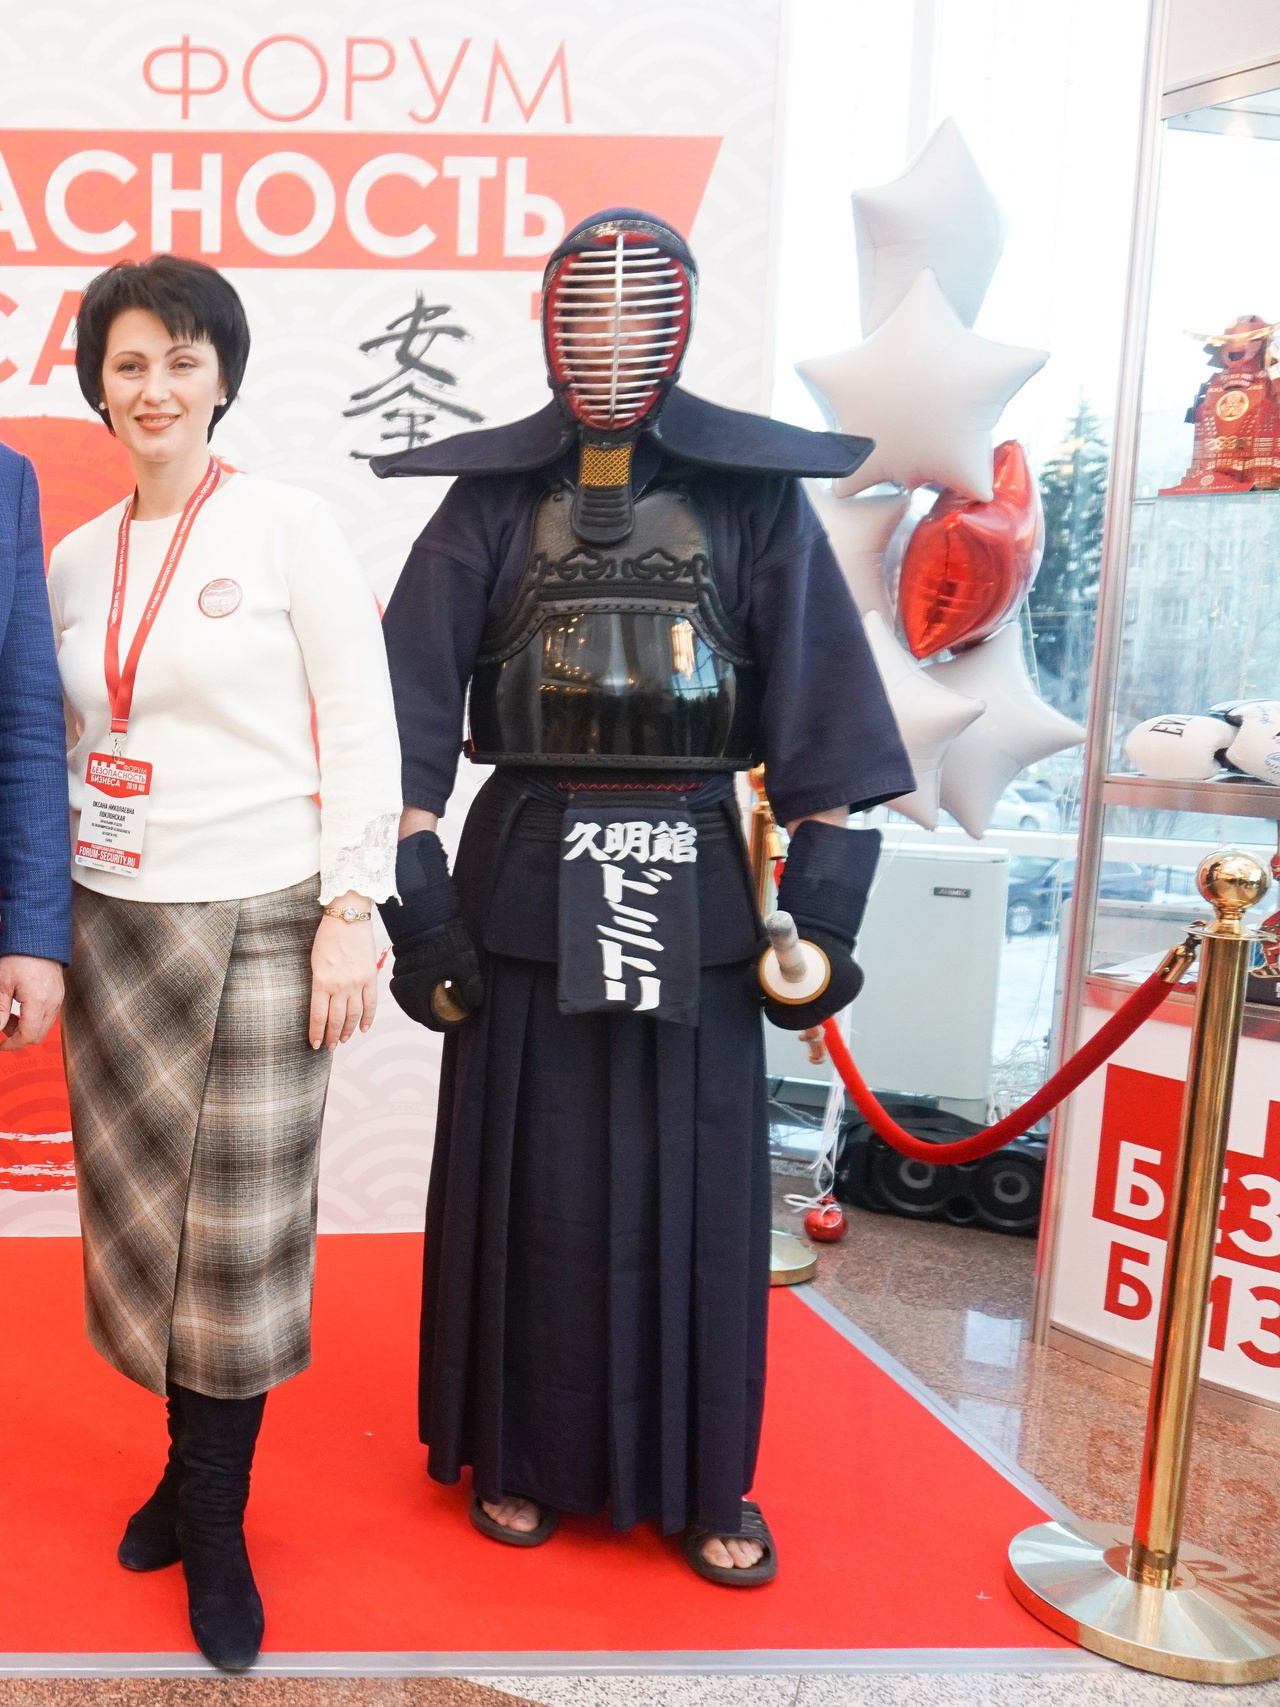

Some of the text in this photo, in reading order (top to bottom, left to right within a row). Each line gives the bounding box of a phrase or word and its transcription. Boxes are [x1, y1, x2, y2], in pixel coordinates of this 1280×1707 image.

[142, 34, 573, 125] ФОРУМ
[90, 775, 120, 787] БИЗНЕСА
[91, 766, 146, 783] БЕЗОПАСНОСТЬ
[79, 846, 136, 867] FORUM-SECURITY.RU
[596, 864, 672, 1011] ドミトリ
